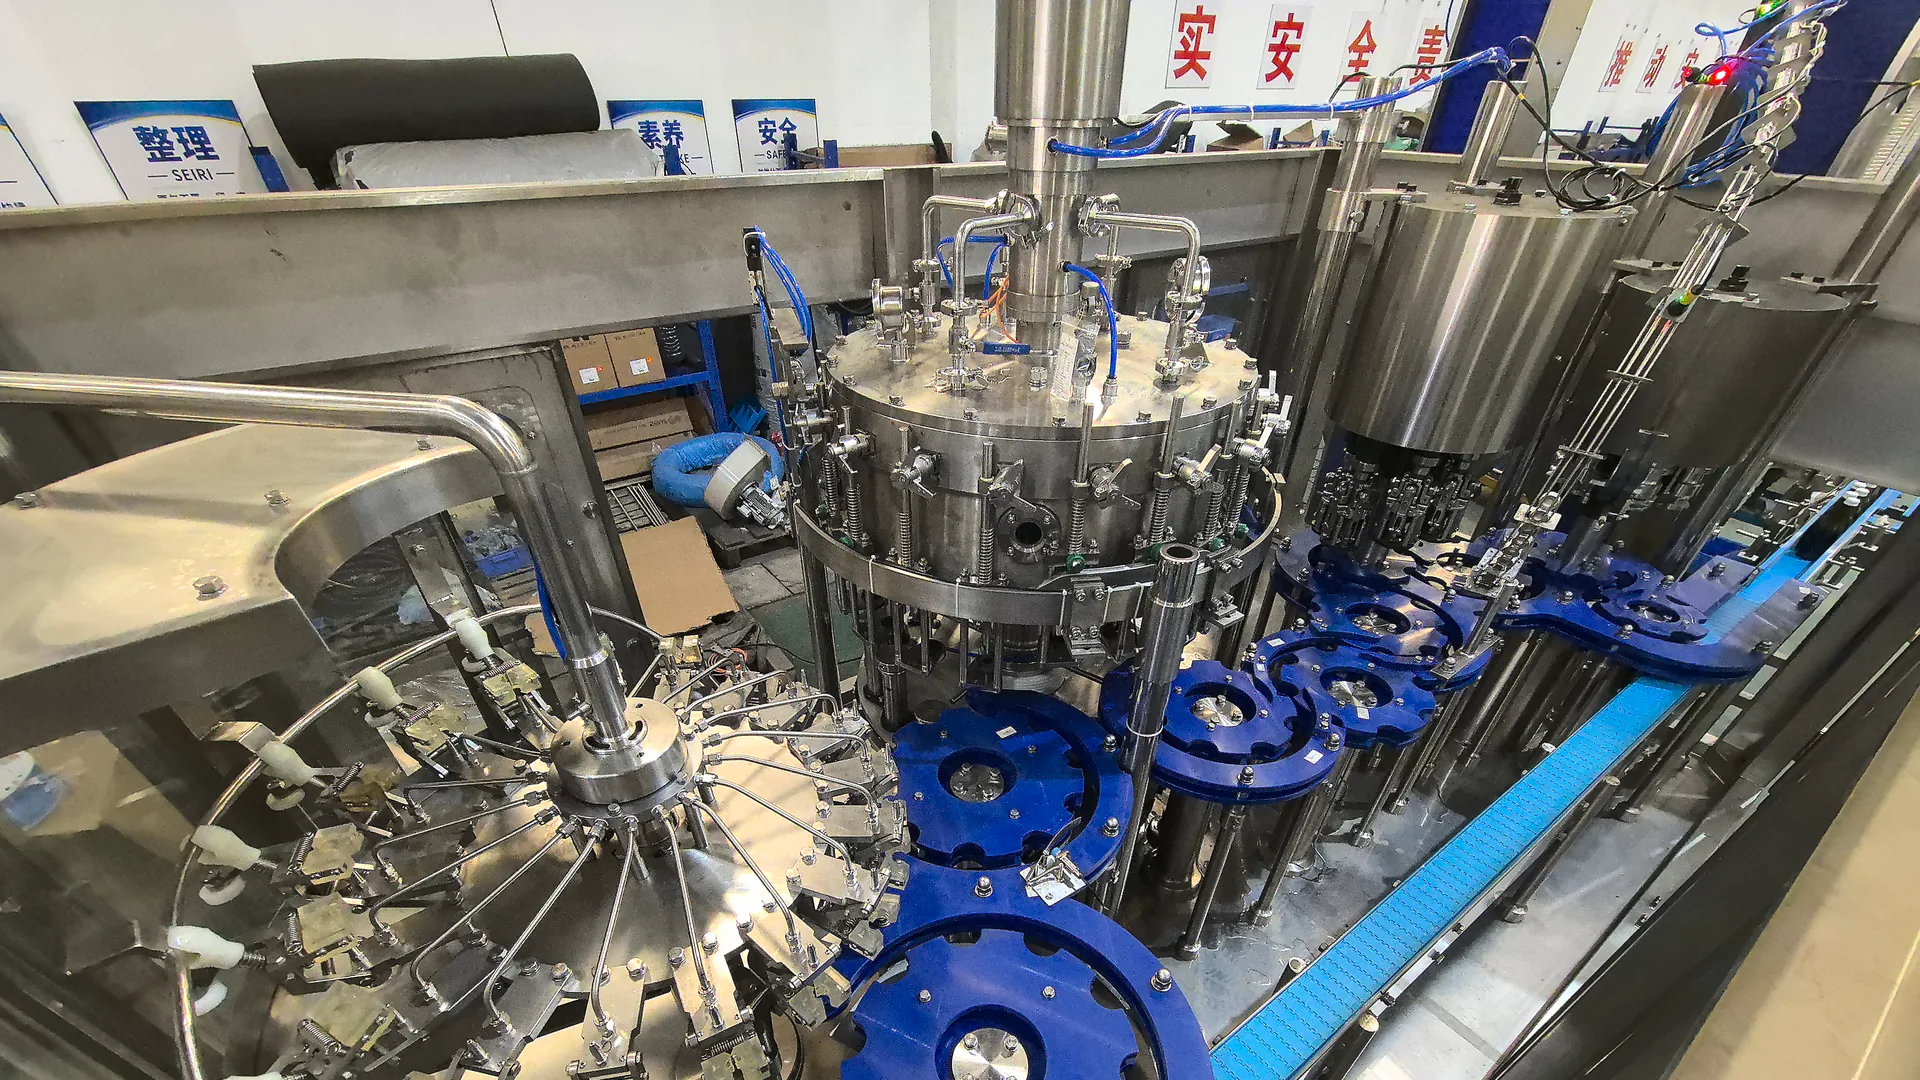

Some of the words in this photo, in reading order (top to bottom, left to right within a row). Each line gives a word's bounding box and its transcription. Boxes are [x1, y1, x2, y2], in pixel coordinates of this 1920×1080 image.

[133, 126, 220, 162] 整理
[637, 119, 684, 149] 素养
[172, 168, 214, 182] SEIRI
